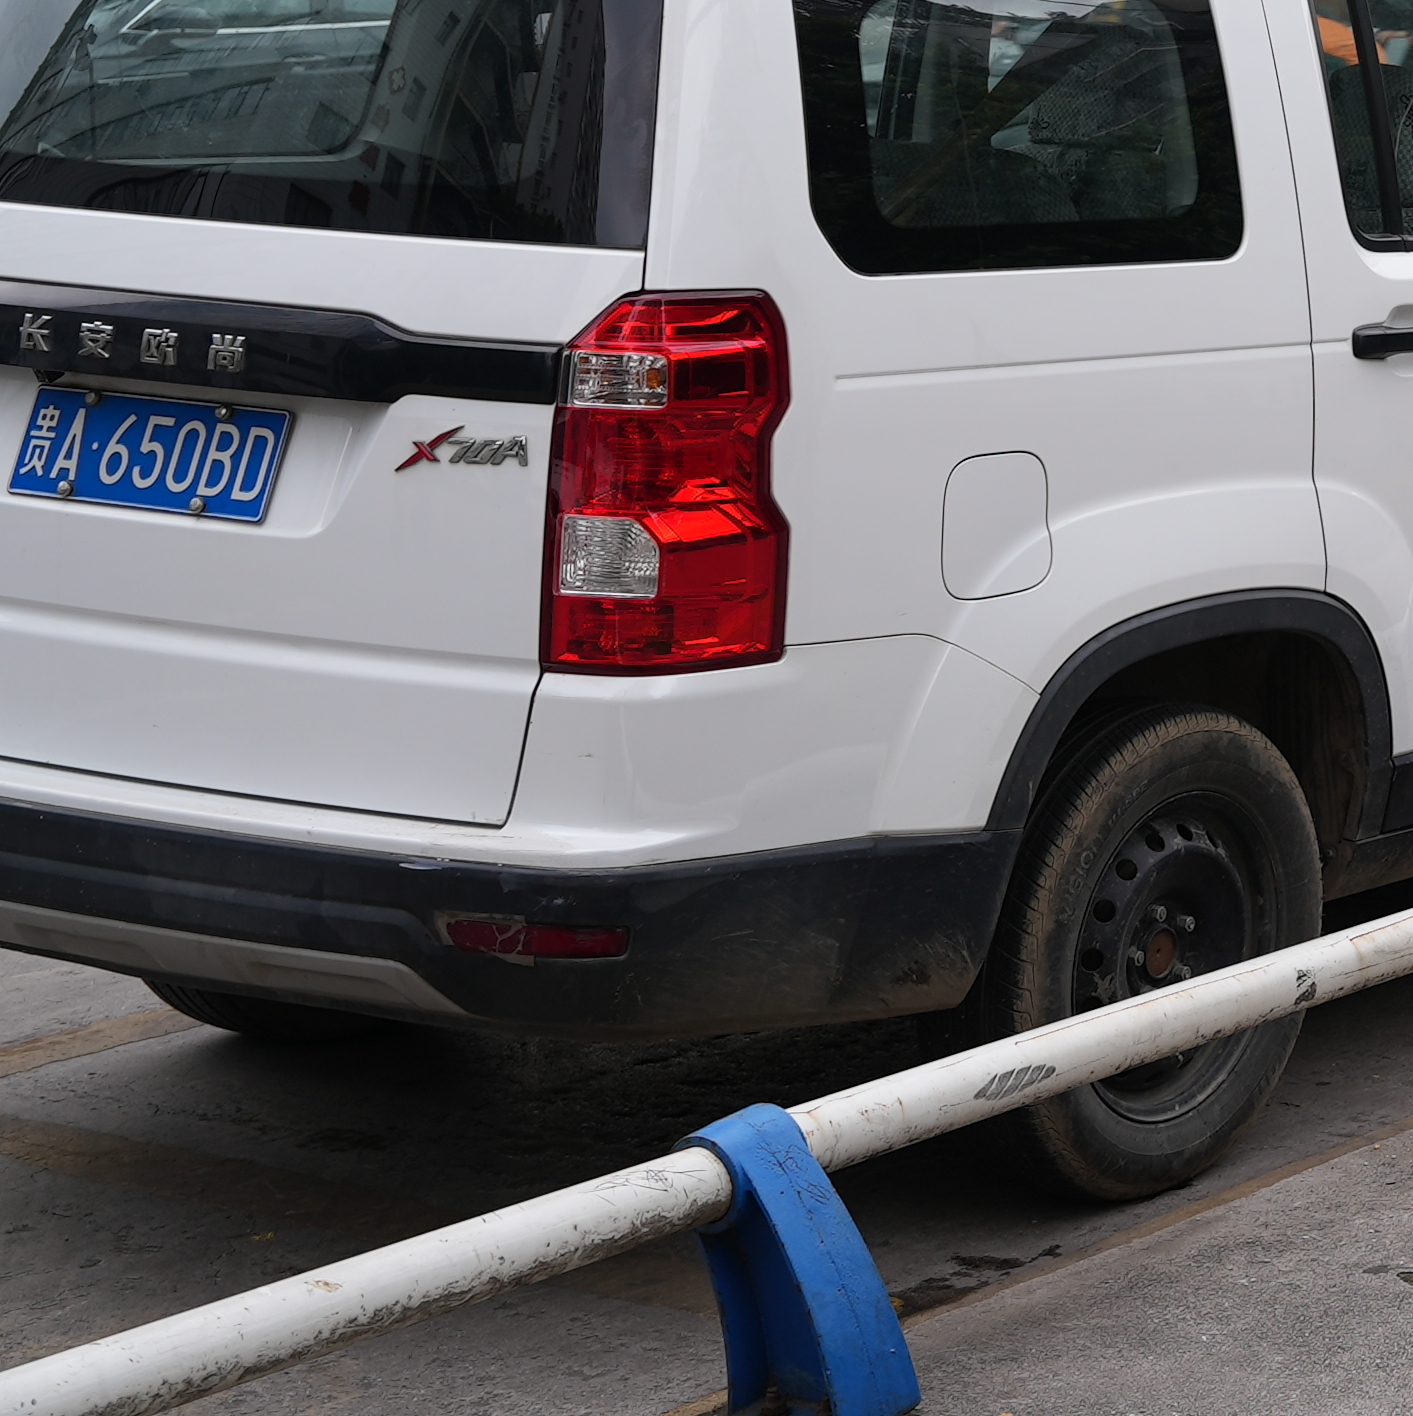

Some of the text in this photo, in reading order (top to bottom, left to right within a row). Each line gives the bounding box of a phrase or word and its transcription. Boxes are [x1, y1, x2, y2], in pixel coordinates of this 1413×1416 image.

[19, 312, 248, 373] 长安欧尚
[394, 424, 529, 472] X70A
